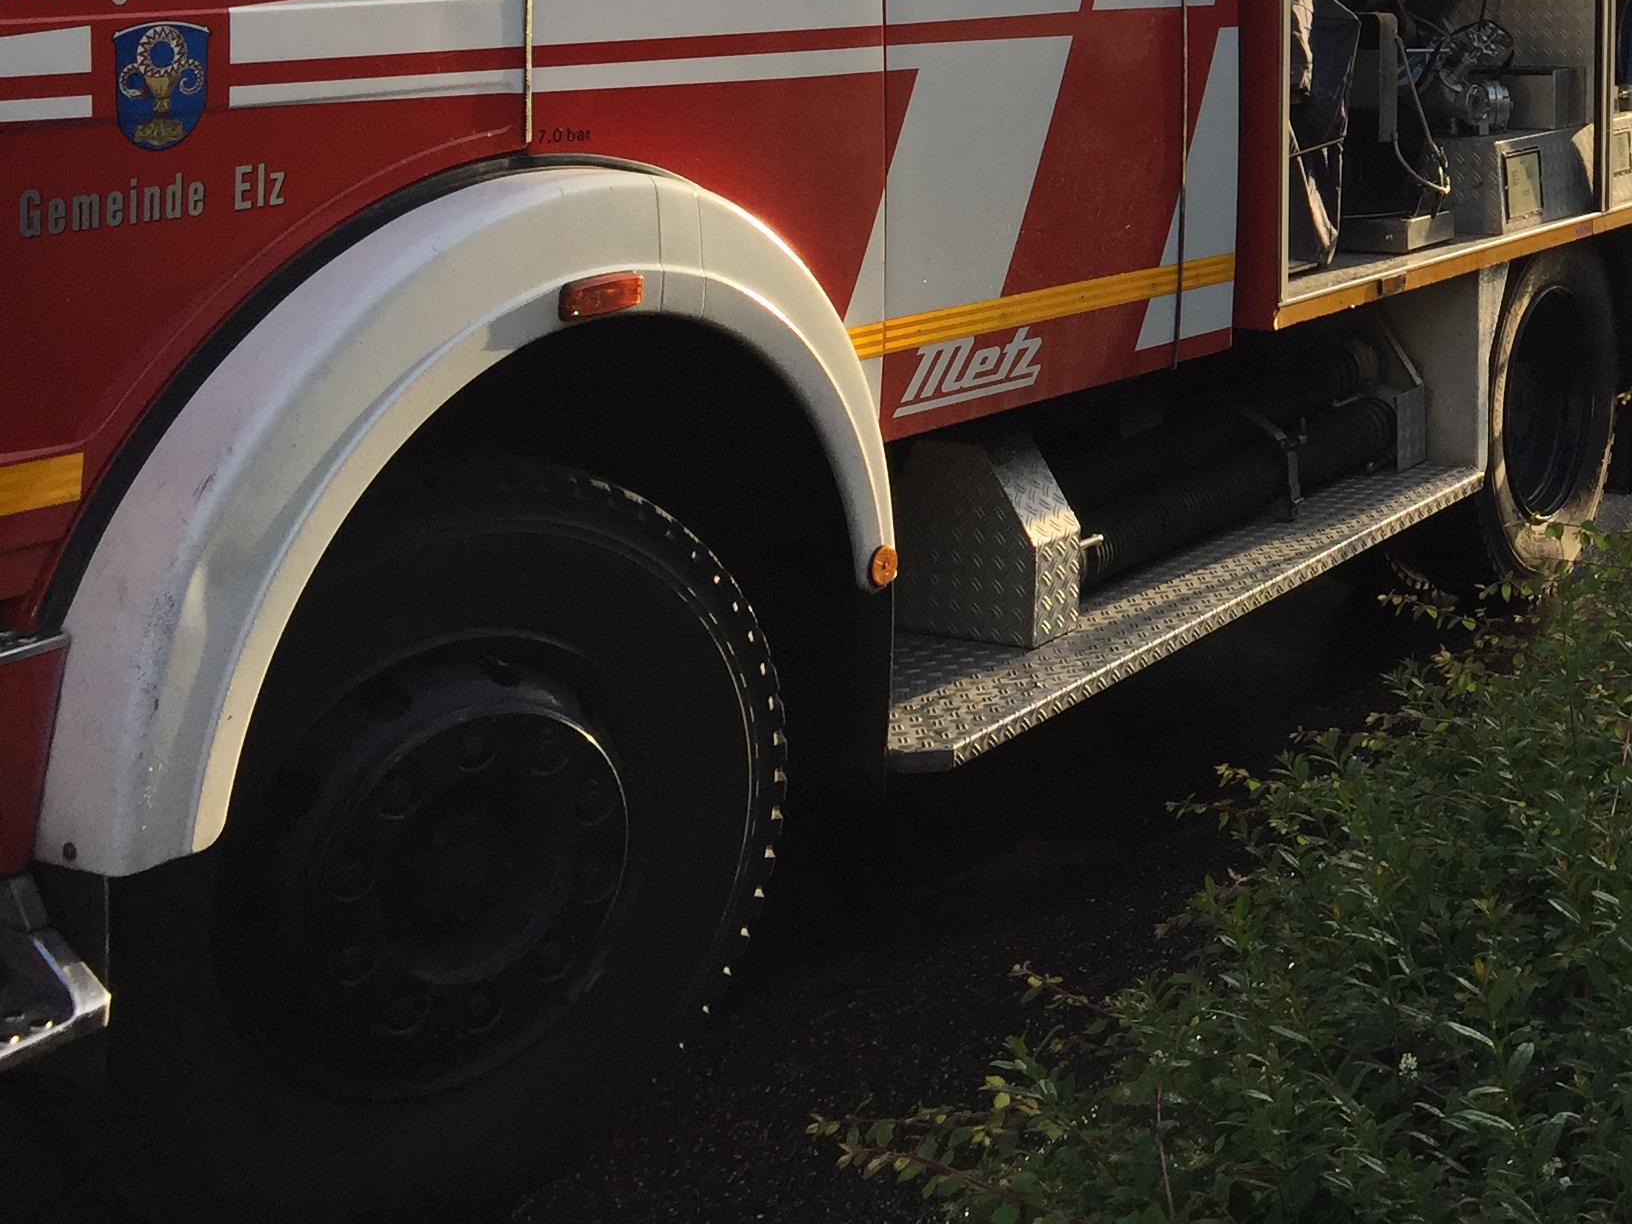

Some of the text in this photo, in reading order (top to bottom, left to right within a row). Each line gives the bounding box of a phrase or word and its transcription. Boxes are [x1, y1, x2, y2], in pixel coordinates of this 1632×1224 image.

[538, 127, 591, 144] 7.0 bar
[19, 162, 286, 238] Gemeinde Elz
[900, 327, 1043, 404] Metz
